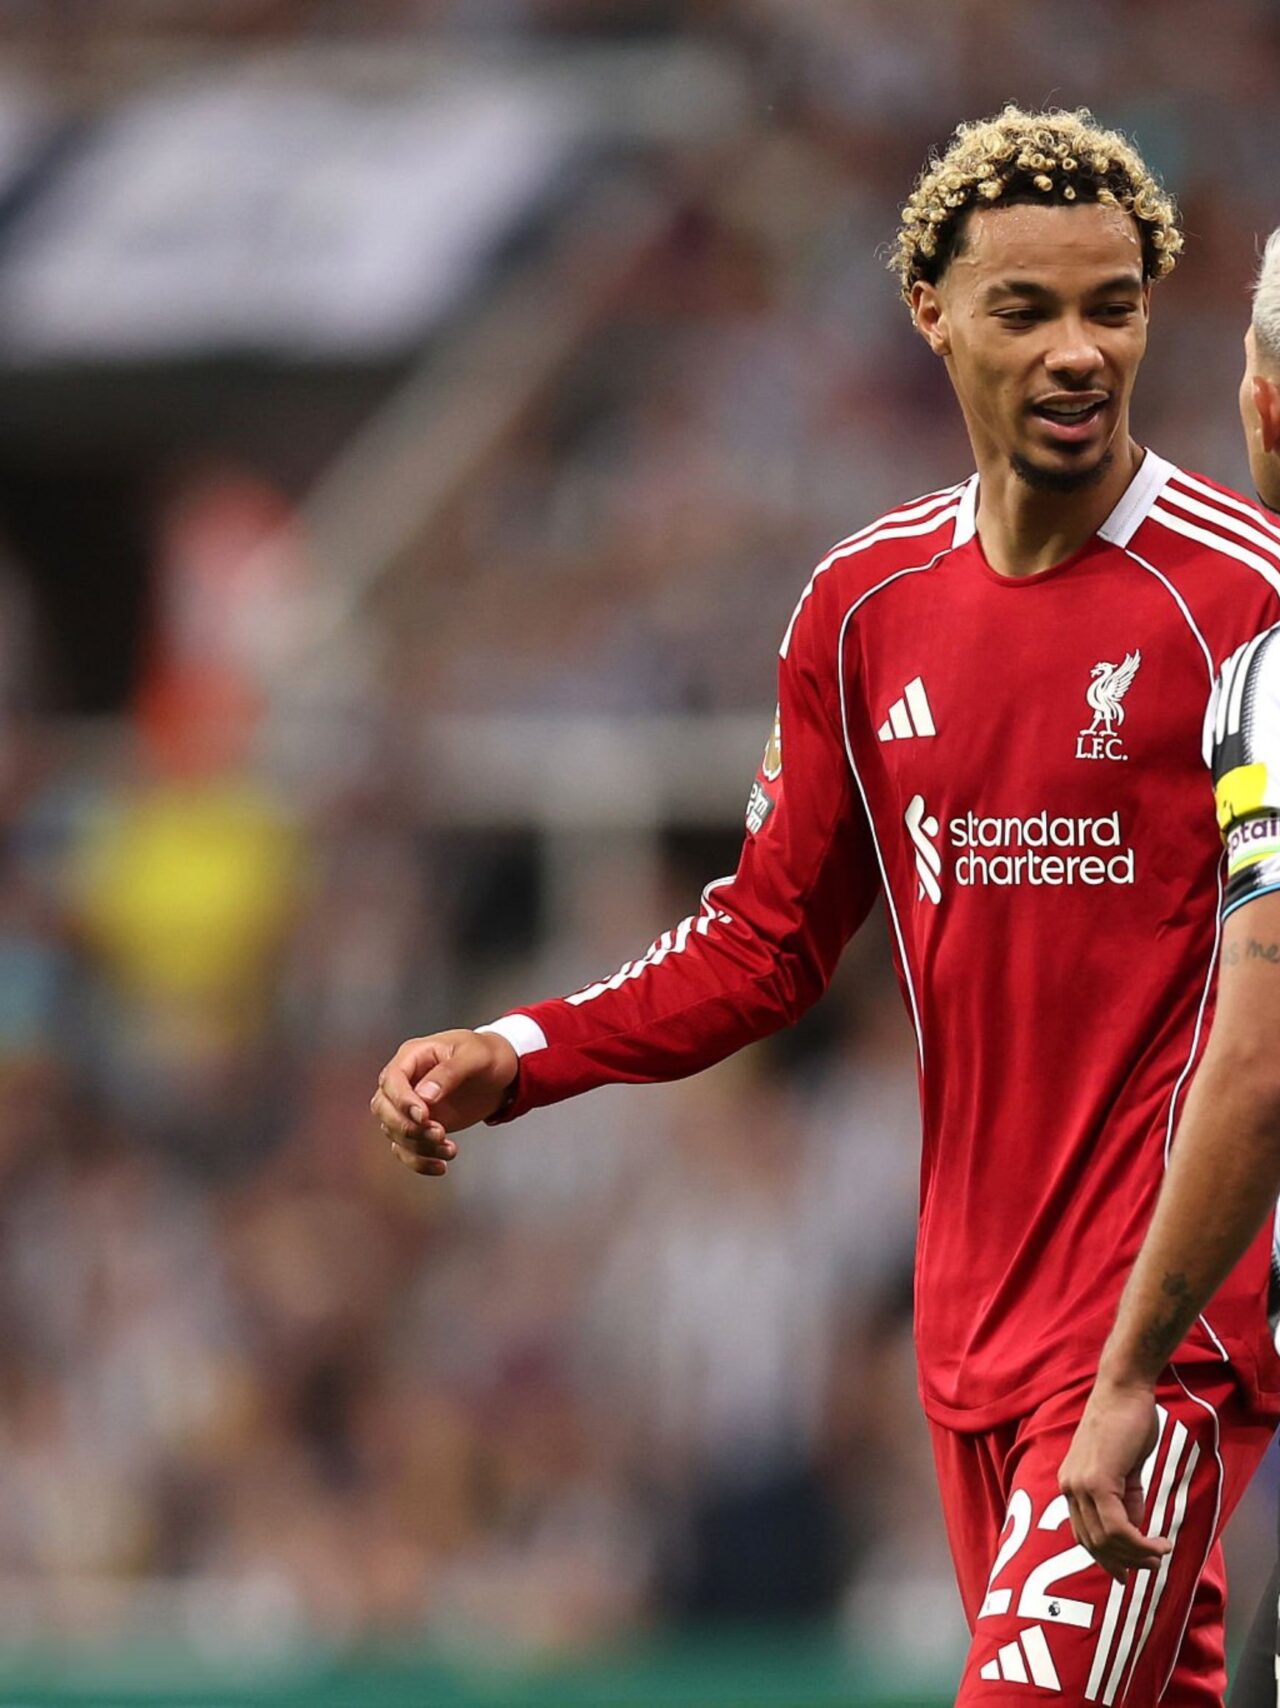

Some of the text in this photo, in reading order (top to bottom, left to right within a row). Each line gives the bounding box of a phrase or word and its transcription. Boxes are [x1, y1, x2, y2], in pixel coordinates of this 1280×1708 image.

[1074, 736, 1129, 761] L.F.C.
[949, 809, 1121, 848] standard
[955, 847, 1135, 886] chartered
[976, 1488, 1097, 1630] 22
